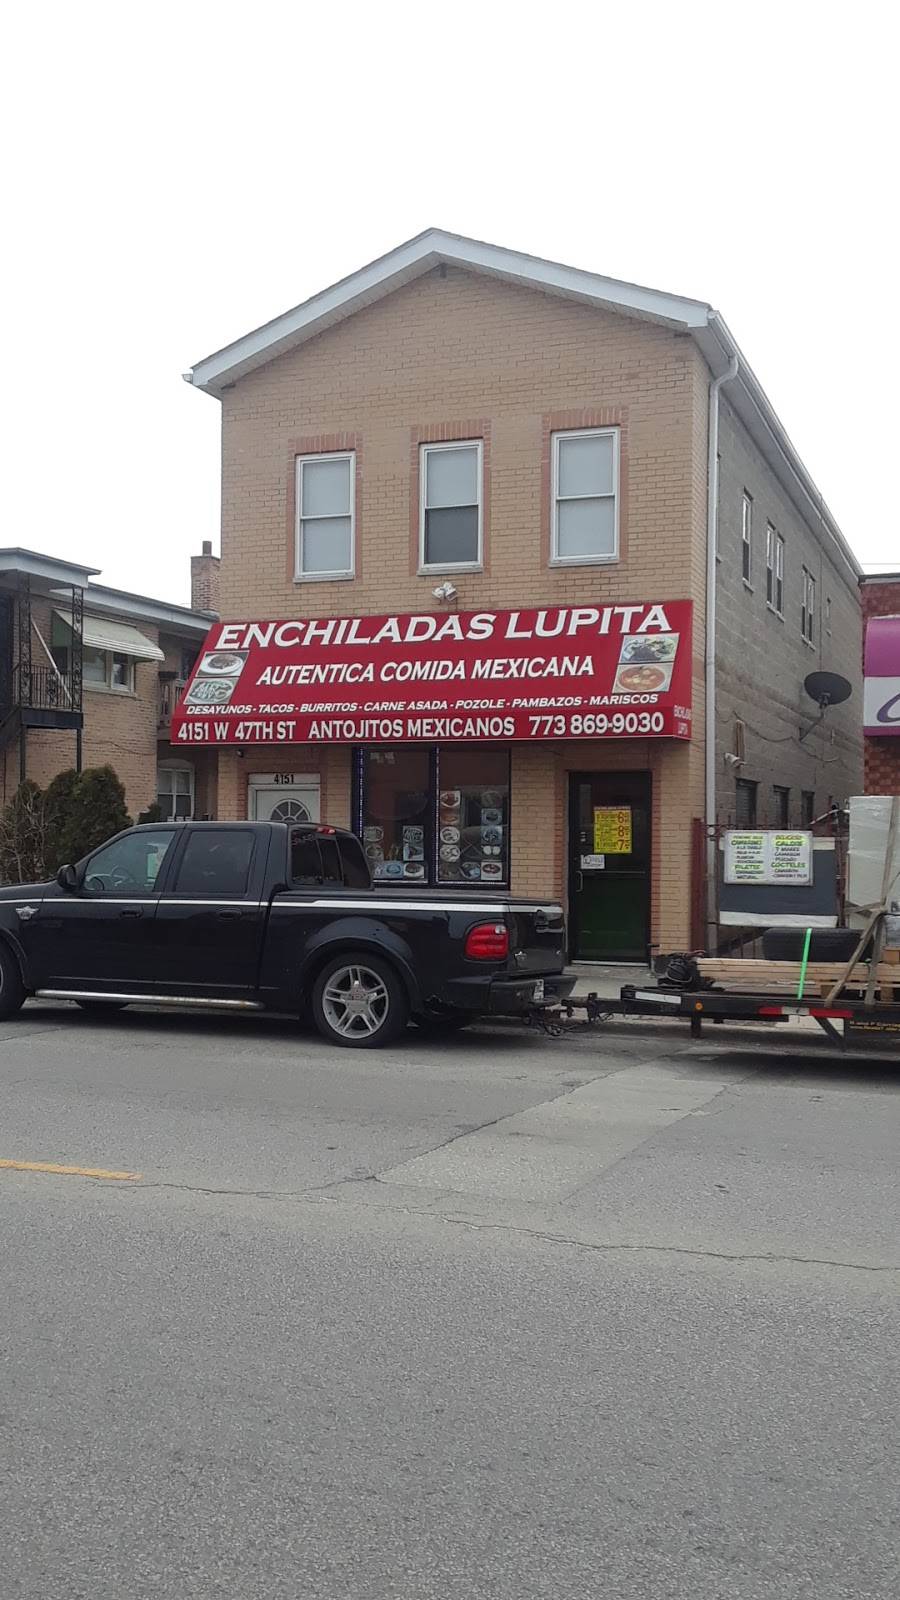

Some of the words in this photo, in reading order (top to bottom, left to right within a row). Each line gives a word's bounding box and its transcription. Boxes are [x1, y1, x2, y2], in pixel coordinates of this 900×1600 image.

[214, 613, 497, 650] ENCHILADAS
[504, 604, 672, 638] LUPITA
[256, 663, 374, 686] AUTENTICA
[380, 659, 466, 683] COMIDA
[471, 655, 595, 680] MEXICANA
[186, 704, 253, 715] DESAYUNOS
[258, 703, 294, 713] TACOS
[299, 702, 358, 713] BURRITOS
[363, 701, 406, 712] CARNE
[406, 700, 448, 711] ASADA
[455, 699, 504, 710] POZOLE
[511, 696, 583, 708] PAMBAZOS
[589, 693, 659, 706] MARISCOS
[178, 722, 209, 741] 4151
[214, 721, 230, 740] W
[234, 721, 273, 740] 47TH
[276, 720, 297, 740] ST
[308, 718, 403, 740] ANTOJITOS
[407, 716, 515, 738] MEXICANOS
[528, 714, 566, 736] 773
[570, 711, 665, 735] 869-9030
[274, 774, 294, 785] 4151
